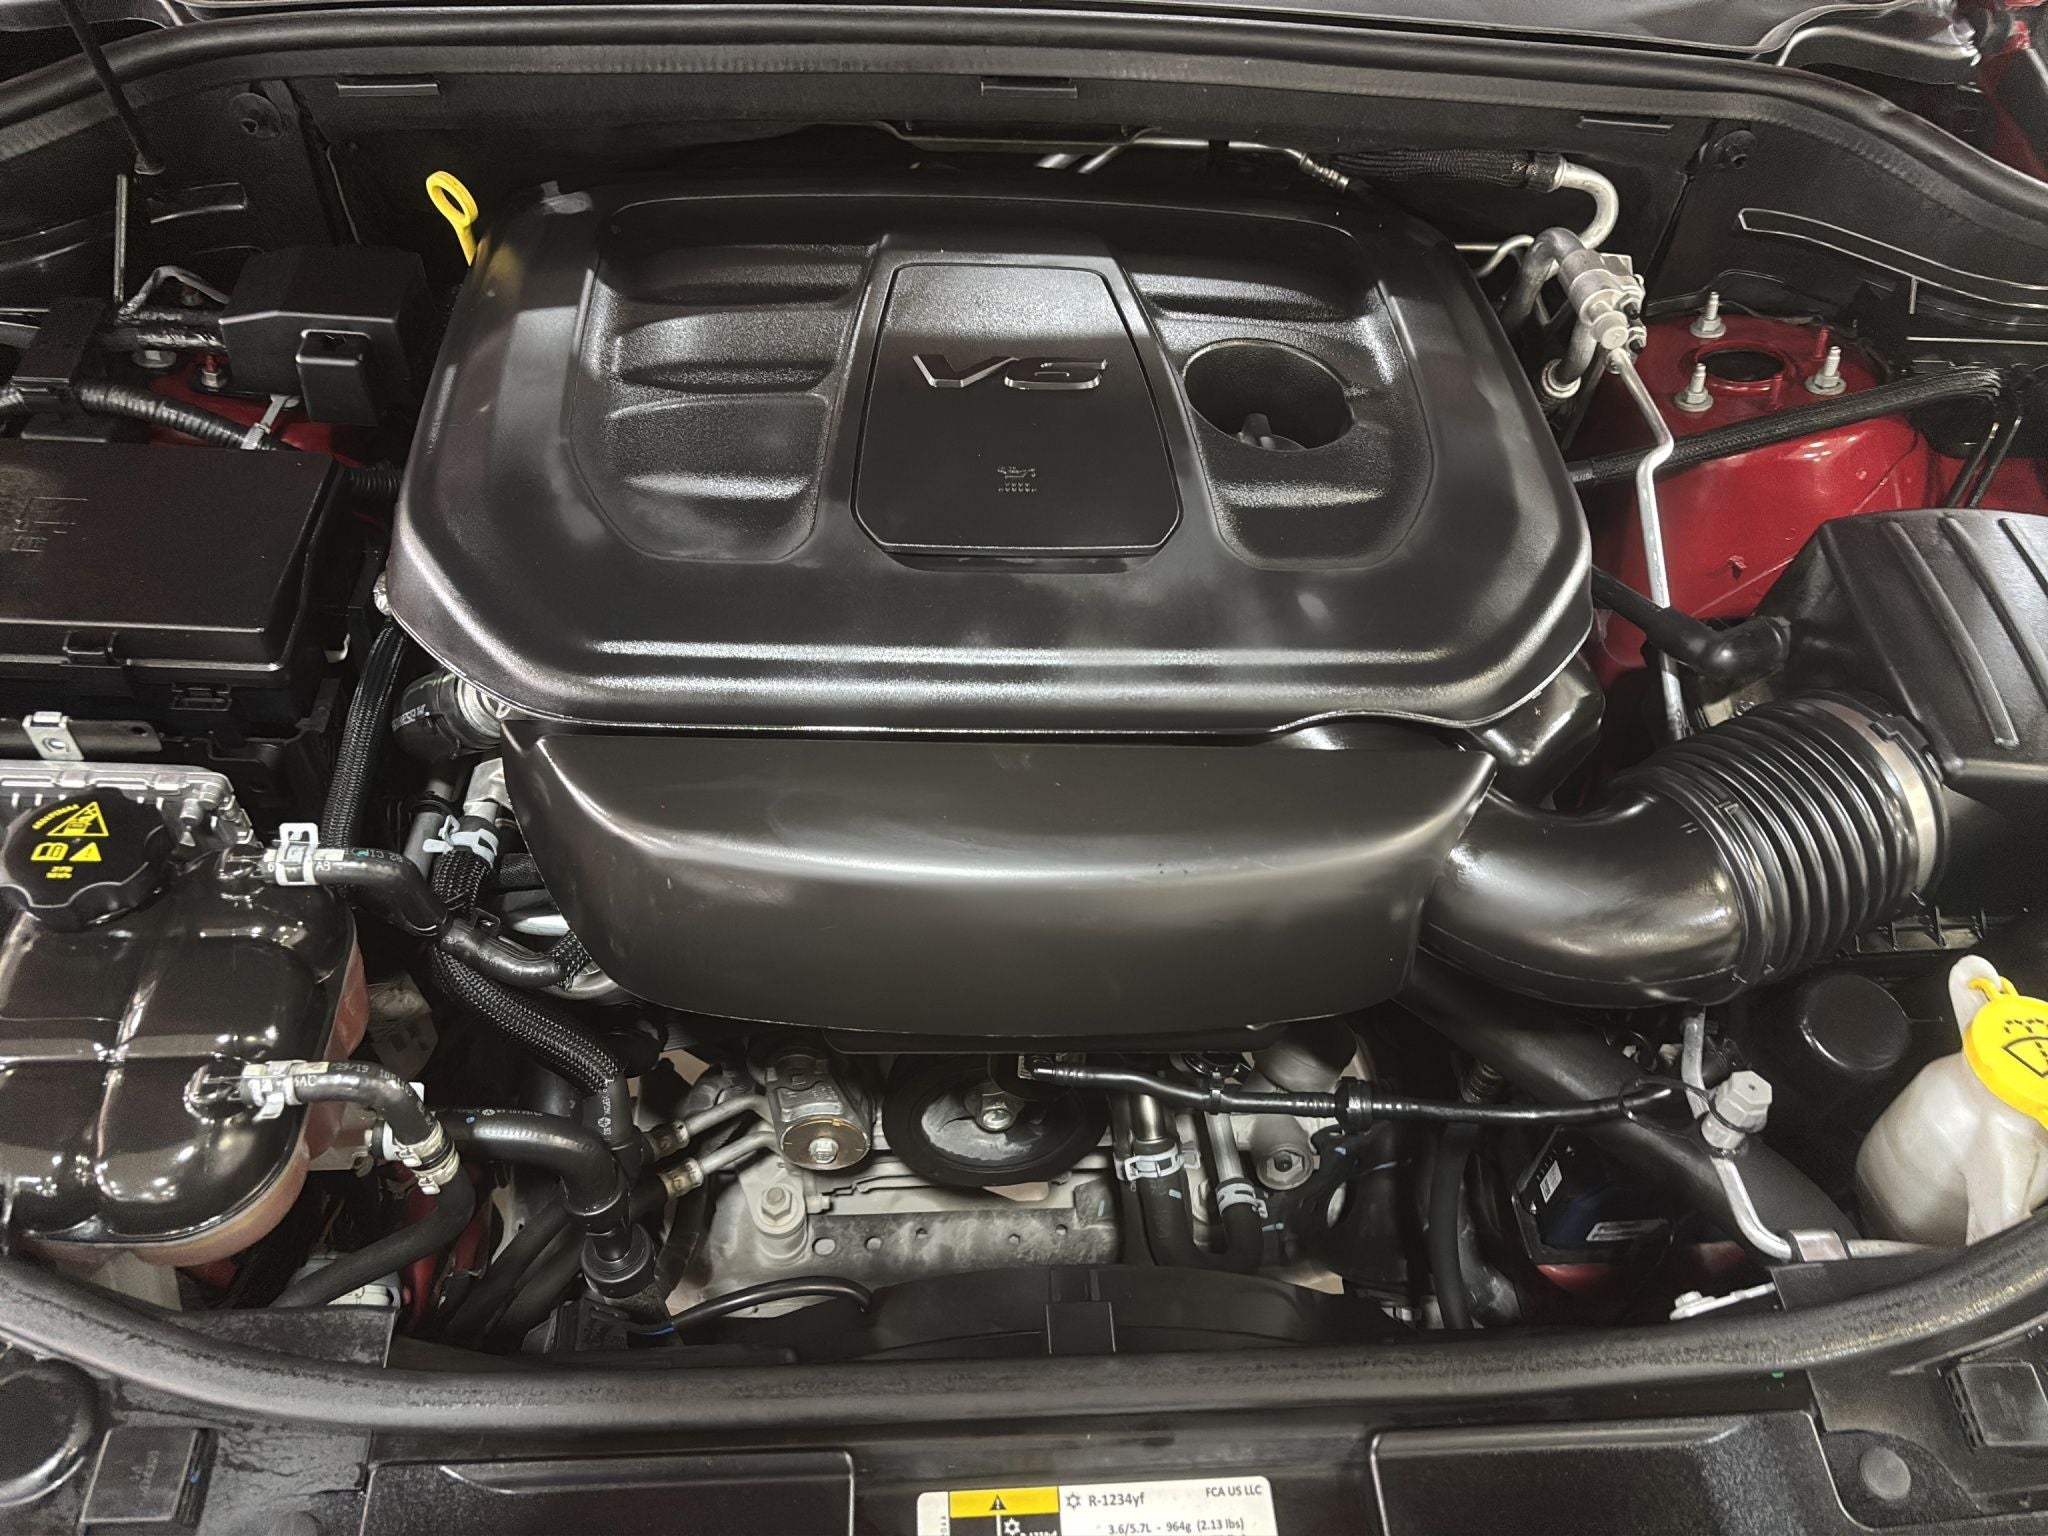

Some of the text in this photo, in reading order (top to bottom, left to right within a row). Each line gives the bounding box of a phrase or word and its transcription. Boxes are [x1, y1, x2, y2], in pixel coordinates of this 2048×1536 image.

[912, 353, 1109, 391] V6
[1205, 1484, 1262, 1497] FCA US LLC
[1088, 1492, 1145, 1508] R-1234yf
[1108, 1522, 1152, 1536] 3.6/5.7L
[1166, 1521, 1191, 1533] 964g
[1197, 1519, 1222, 1532] (2.13
[1225, 1518, 1245, 1530] lbs)
